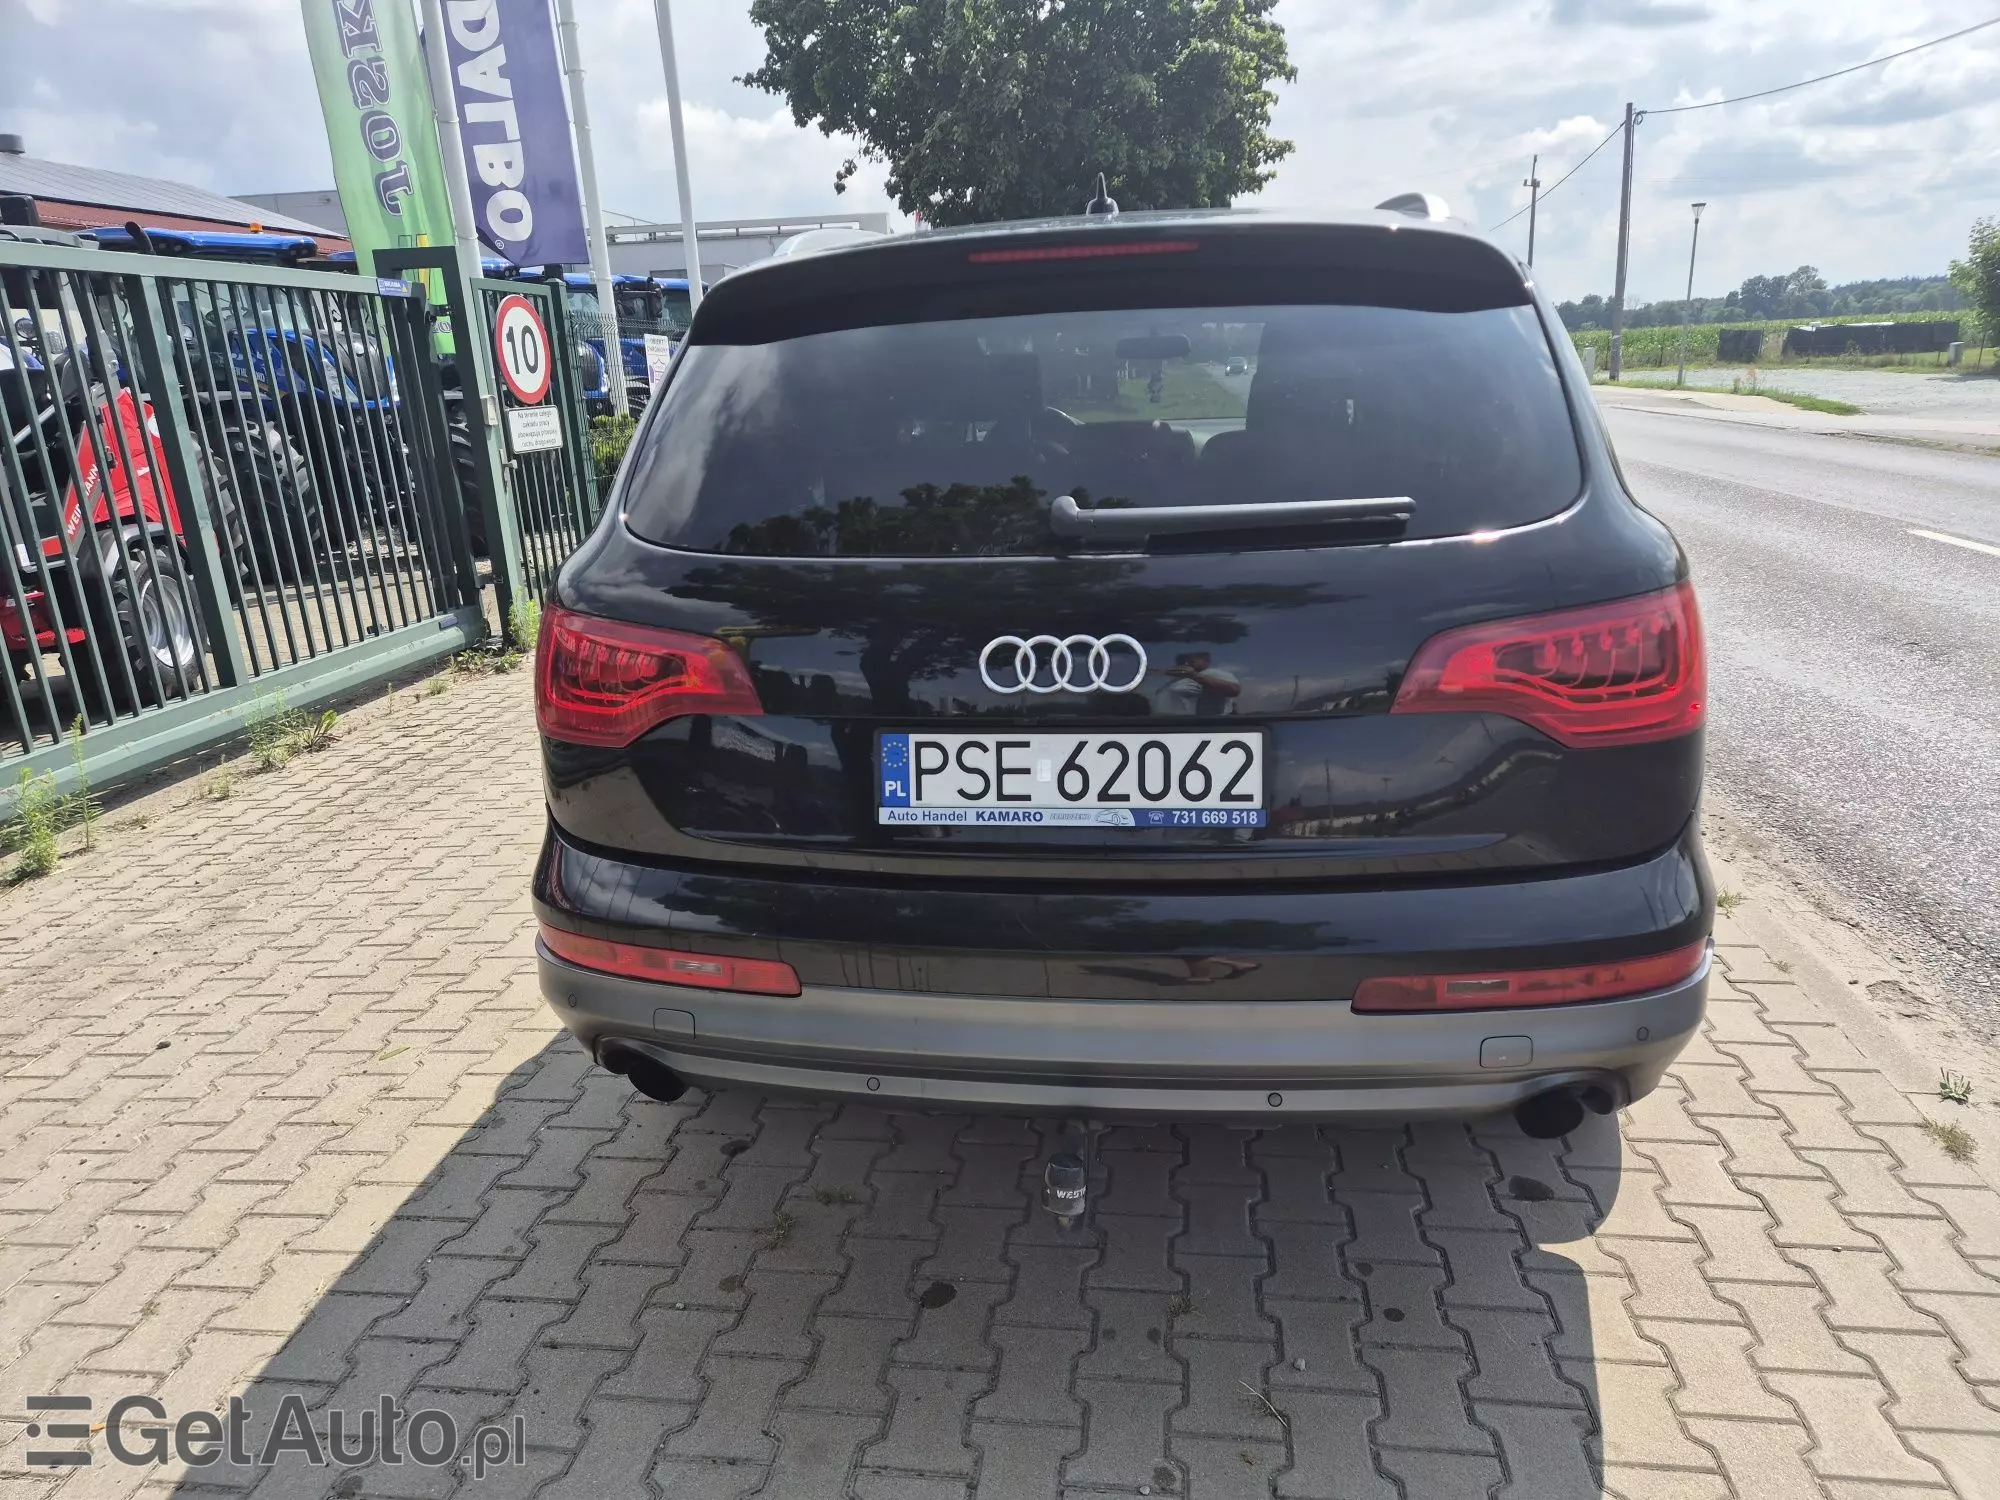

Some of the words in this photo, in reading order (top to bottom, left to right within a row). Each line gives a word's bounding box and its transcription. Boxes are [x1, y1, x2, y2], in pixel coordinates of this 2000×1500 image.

[506, 325, 539, 375] 10
[915, 740, 1032, 801] PSE
[1057, 740, 1254, 802] 62062
[884, 780, 907, 797] PL
[887, 810, 918, 822] Auto
[922, 810, 967, 822] Handel
[975, 811, 1044, 822] KAMARO
[1172, 810, 1197, 824] 731
[1202, 810, 1228, 824] 669
[1232, 810, 1258, 824] 518
